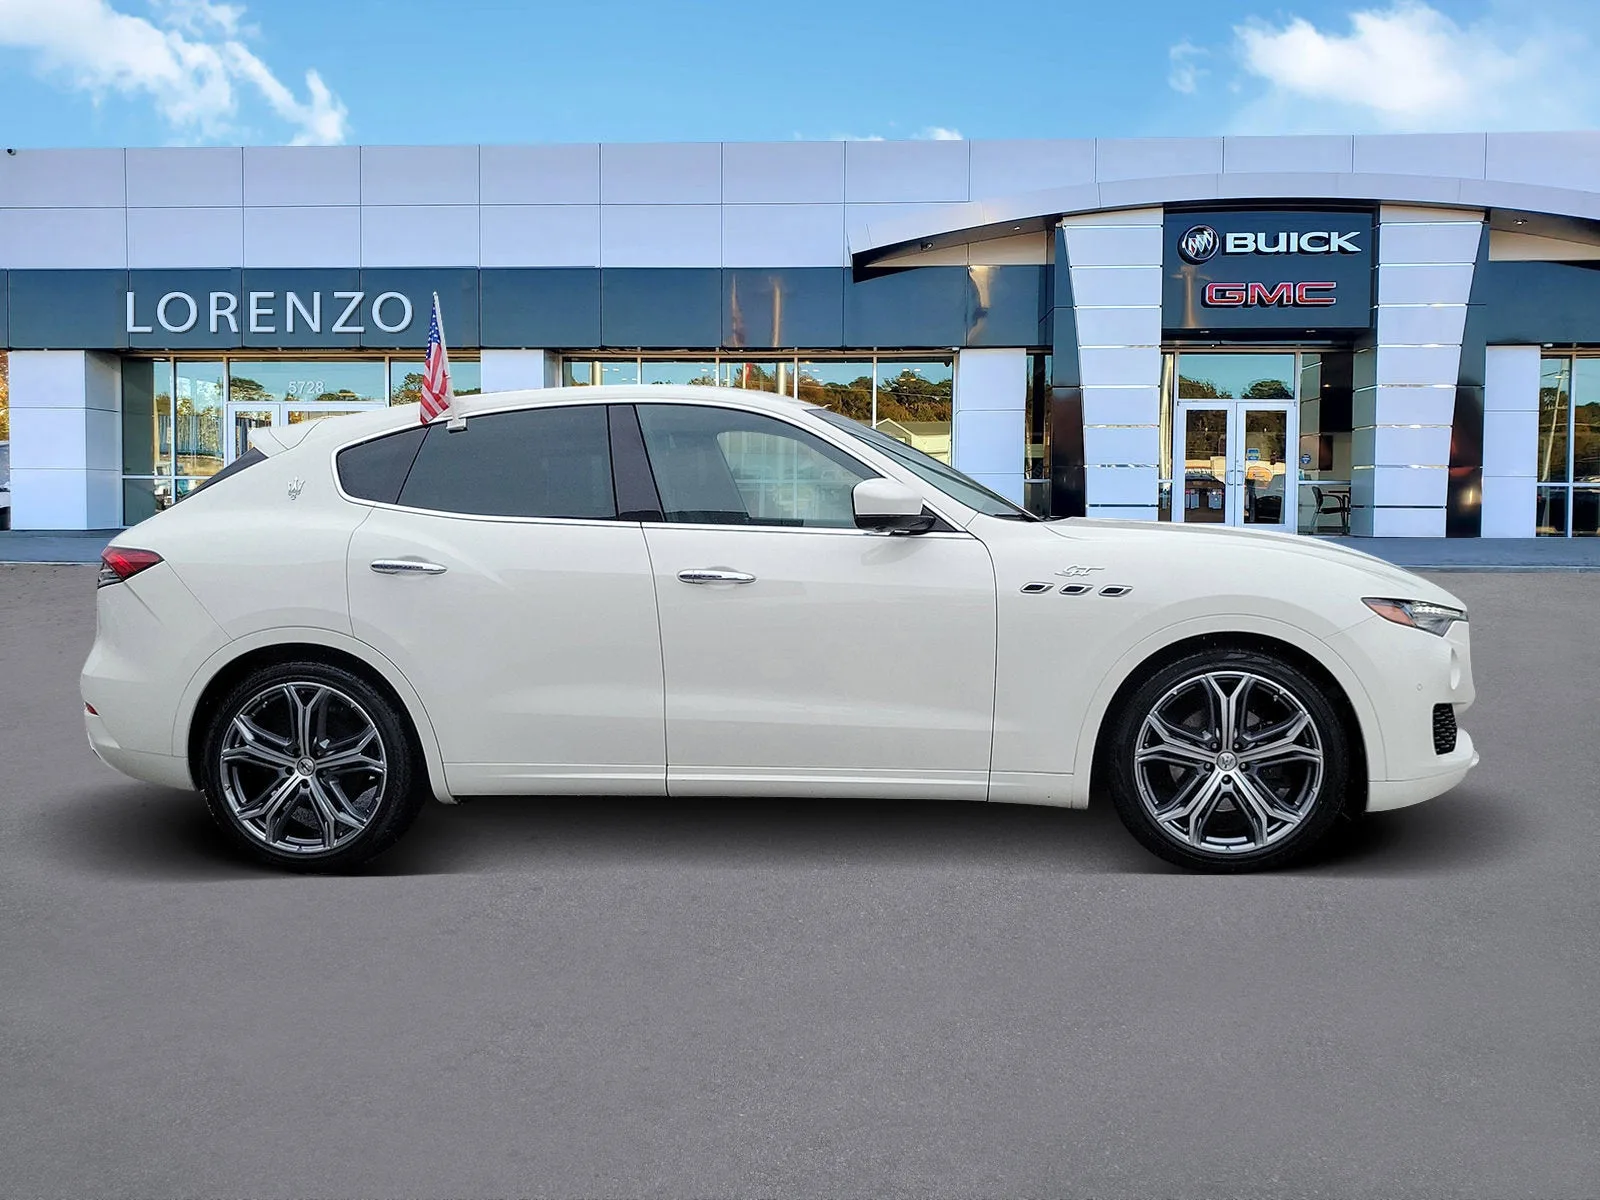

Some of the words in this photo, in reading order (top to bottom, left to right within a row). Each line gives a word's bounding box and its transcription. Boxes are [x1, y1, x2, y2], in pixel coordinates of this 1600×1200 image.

[1226, 231, 1362, 253] BUICK
[1205, 282, 1337, 305] GMC
[126, 291, 413, 333] LORENZO
[288, 381, 325, 394] 5728
